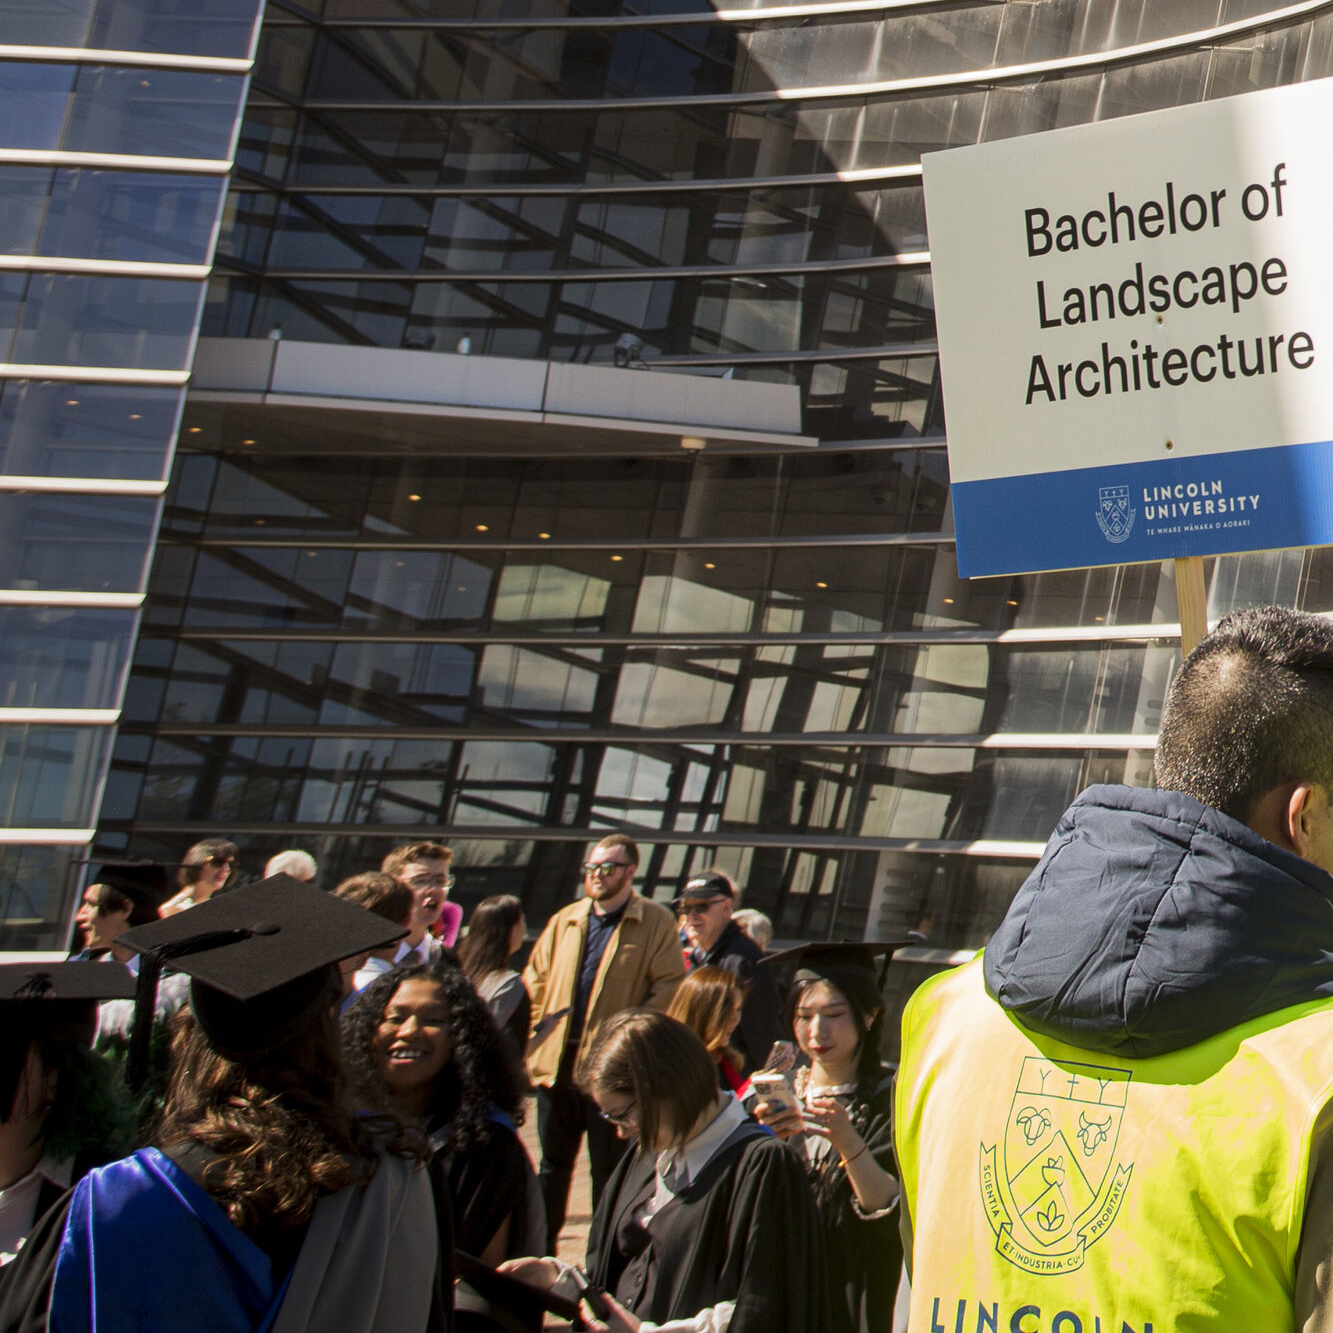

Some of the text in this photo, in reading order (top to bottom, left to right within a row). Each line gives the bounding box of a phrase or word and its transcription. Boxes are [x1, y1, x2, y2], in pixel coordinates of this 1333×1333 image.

[1024, 162, 1288, 258] Bachelor of
[1036, 254, 1289, 330] Landscape
[1025, 329, 1315, 405] Architecture
[1143, 480, 1223, 503] LINCOLN
[1144, 494, 1261, 521] UNIVERSITY
[1146, 528, 1155, 536] TE
[1157, 525, 1182, 535] WHARE
[1223, 519, 1251, 529] AORAKI
[983, 1164, 1001, 1218] SCIENTIA
[1090, 1180, 1124, 1234] PROBITATE
